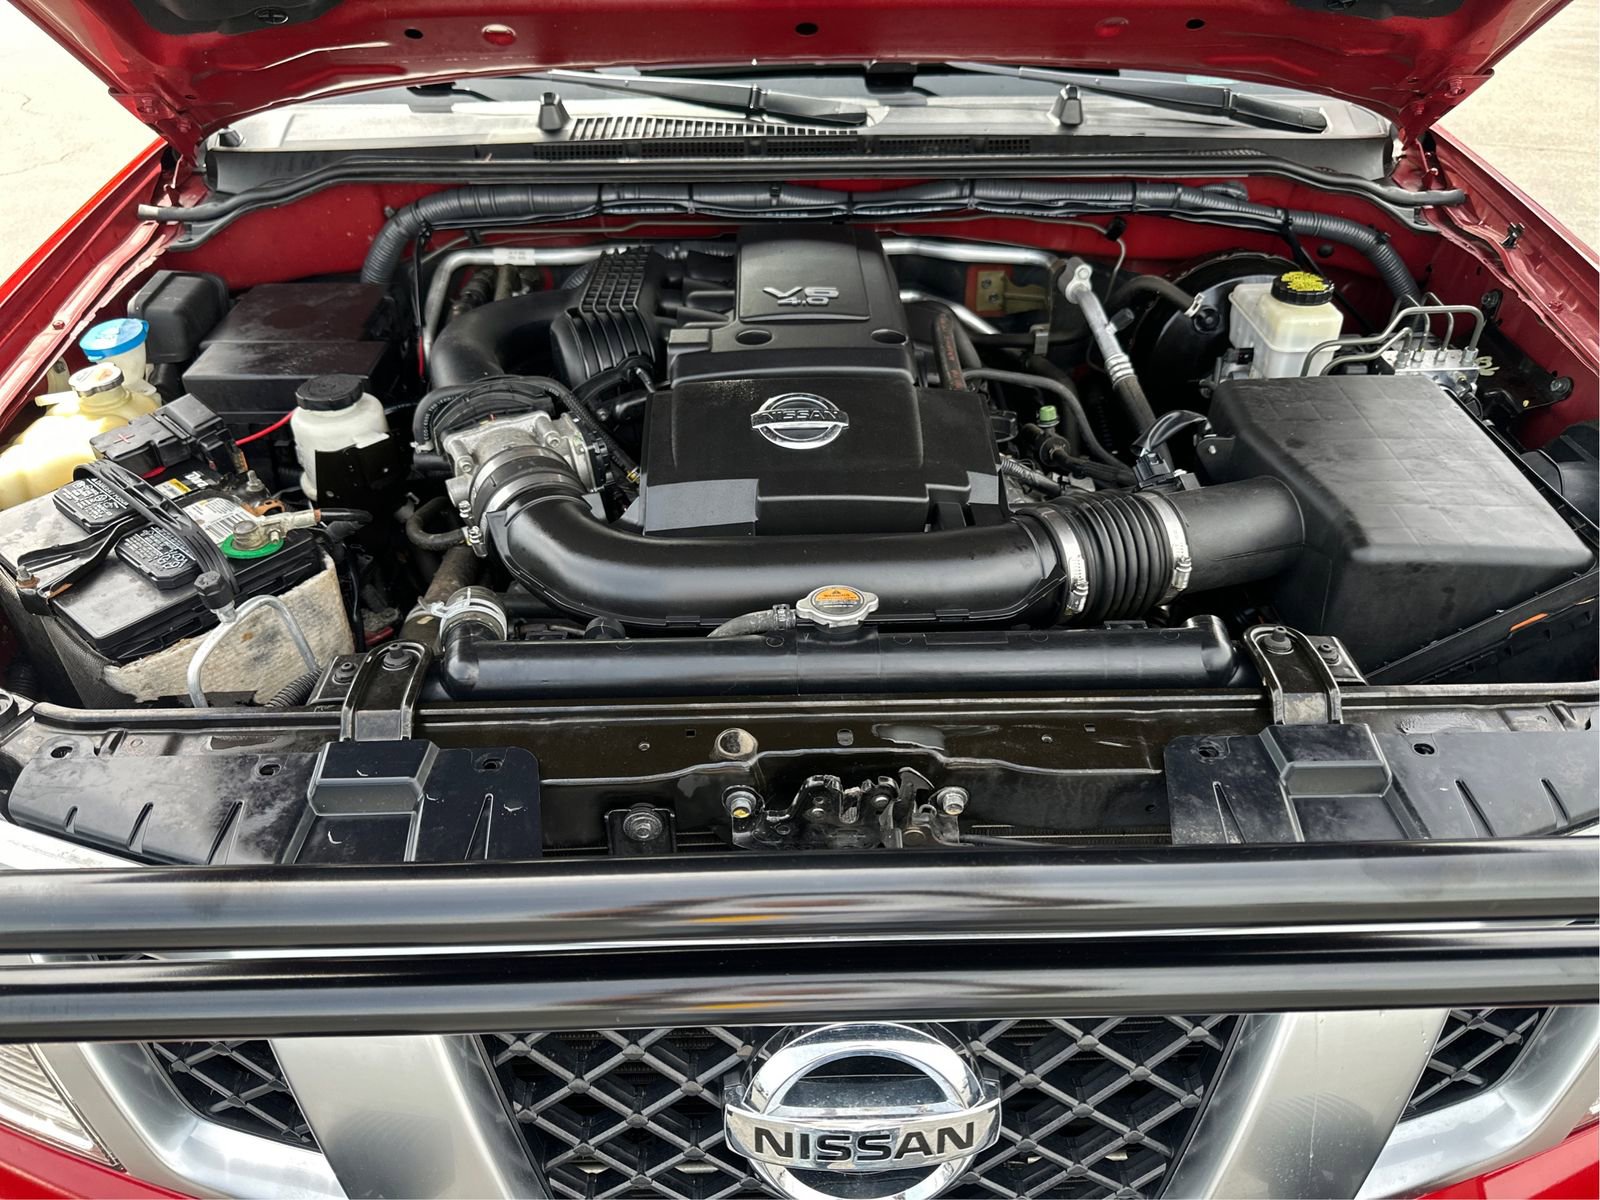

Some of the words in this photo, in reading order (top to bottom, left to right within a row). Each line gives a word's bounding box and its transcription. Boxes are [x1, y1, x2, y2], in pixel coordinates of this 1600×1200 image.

[763, 286, 839, 299] V6
[777, 297, 829, 306] 4.0
[760, 409, 839, 421] NISSAN
[754, 1121, 975, 1161] NISSAN
